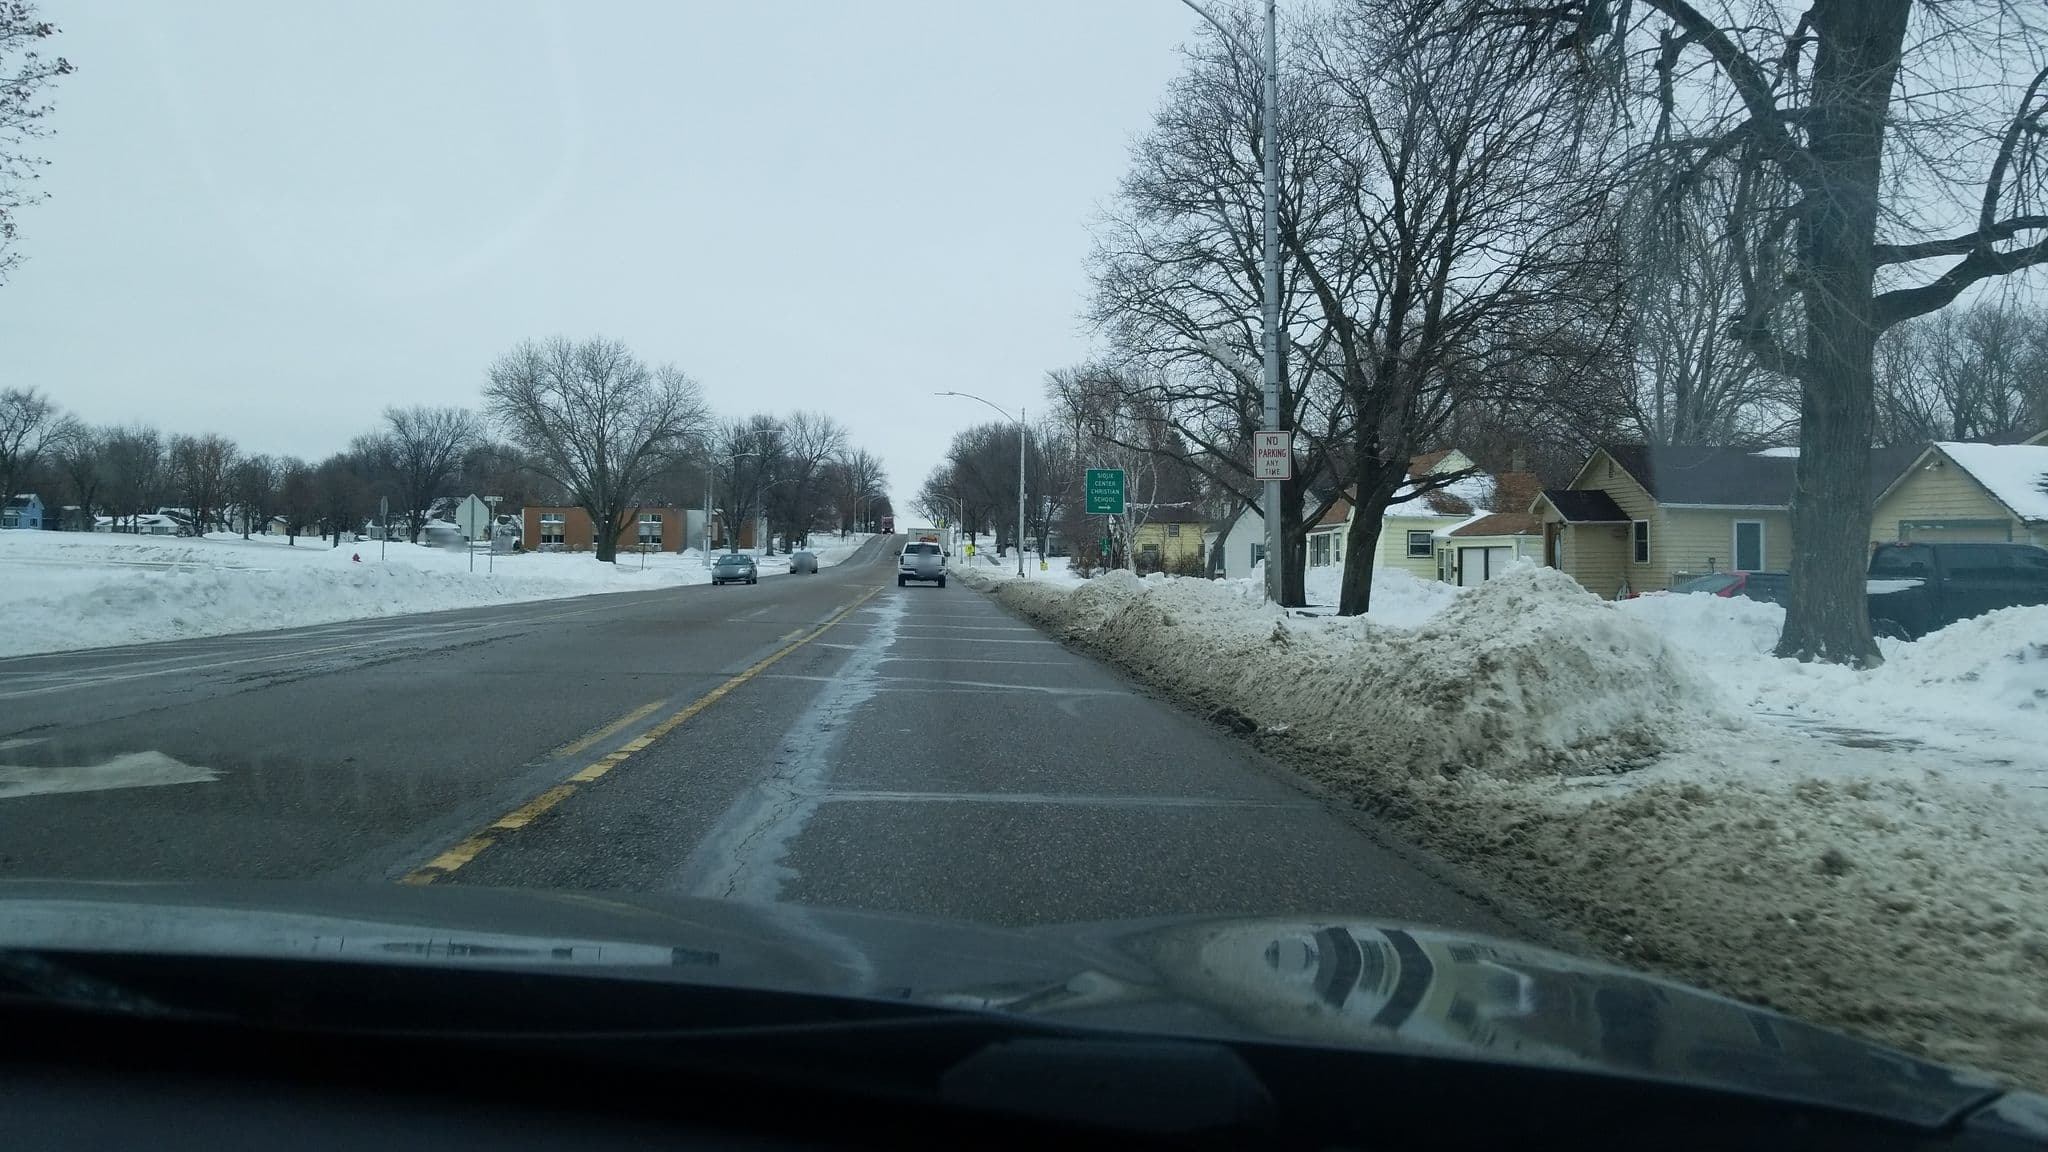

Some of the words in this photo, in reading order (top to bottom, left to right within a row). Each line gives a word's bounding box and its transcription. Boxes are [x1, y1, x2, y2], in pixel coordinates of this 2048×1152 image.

[1266, 436, 1279, 446] NO
[1258, 448, 1287, 458] PARKING
[1266, 459, 1279, 467] ANY
[1264, 468, 1280, 476] TIME
